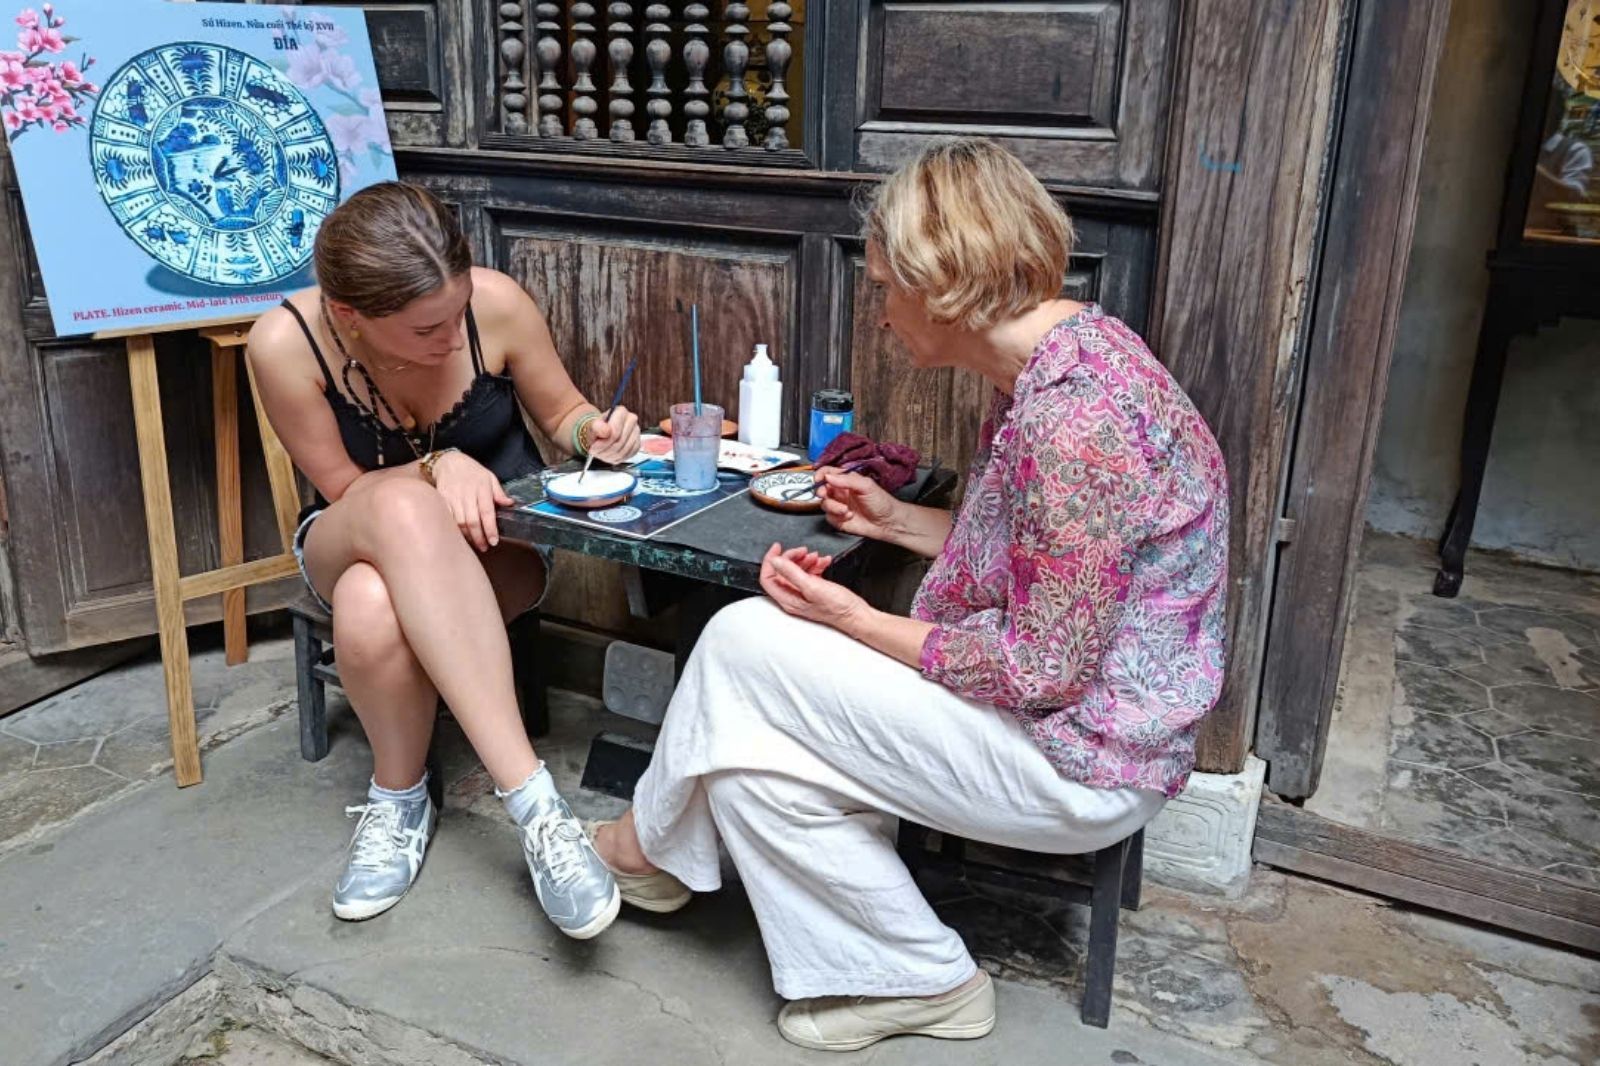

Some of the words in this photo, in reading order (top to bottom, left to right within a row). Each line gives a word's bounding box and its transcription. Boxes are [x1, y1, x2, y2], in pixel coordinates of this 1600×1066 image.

[315, 21, 334, 31] XVII
[112, 306, 142, 317] Hizen
[143, 301, 184, 313] ceramic.
[186, 298, 227, 310] Mid-late
[229, 293, 250, 305] 17th
